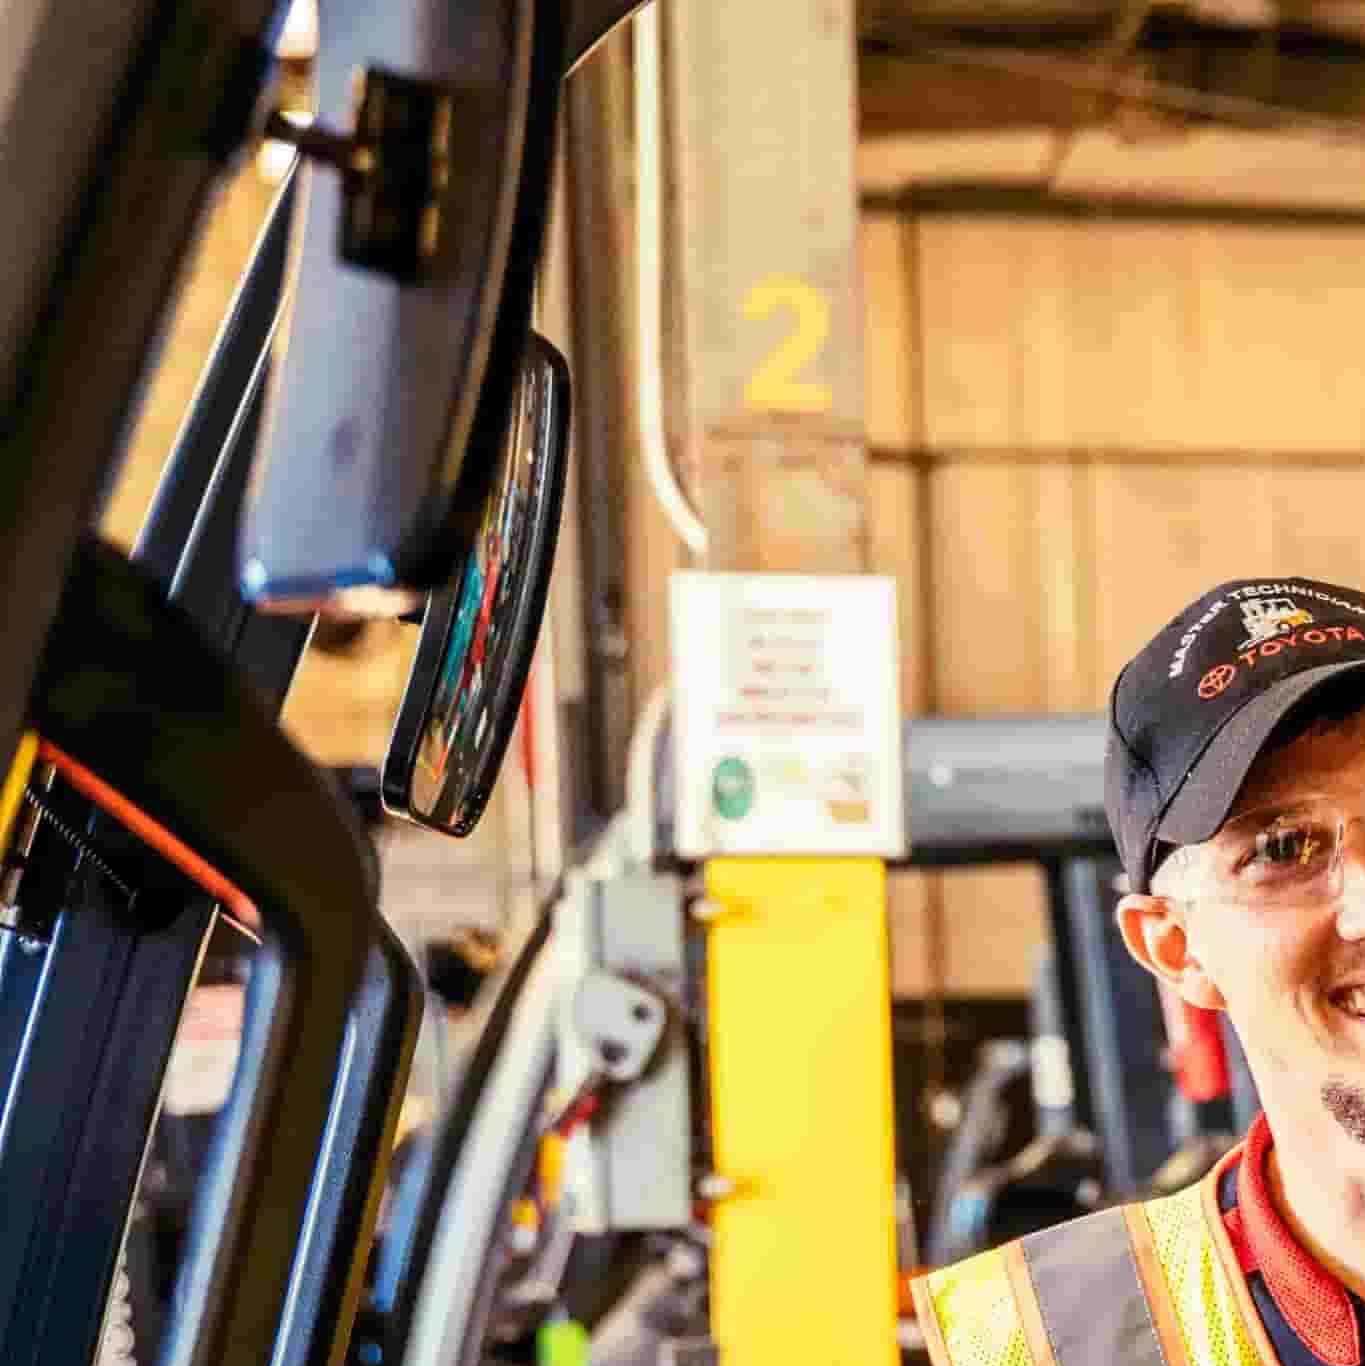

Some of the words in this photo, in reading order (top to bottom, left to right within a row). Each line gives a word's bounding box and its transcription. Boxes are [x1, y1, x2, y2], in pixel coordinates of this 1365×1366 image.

[742, 278, 832, 411] 2
[1168, 599, 1229, 679] MASTER
[1238, 626, 1365, 667] TOYOTA
